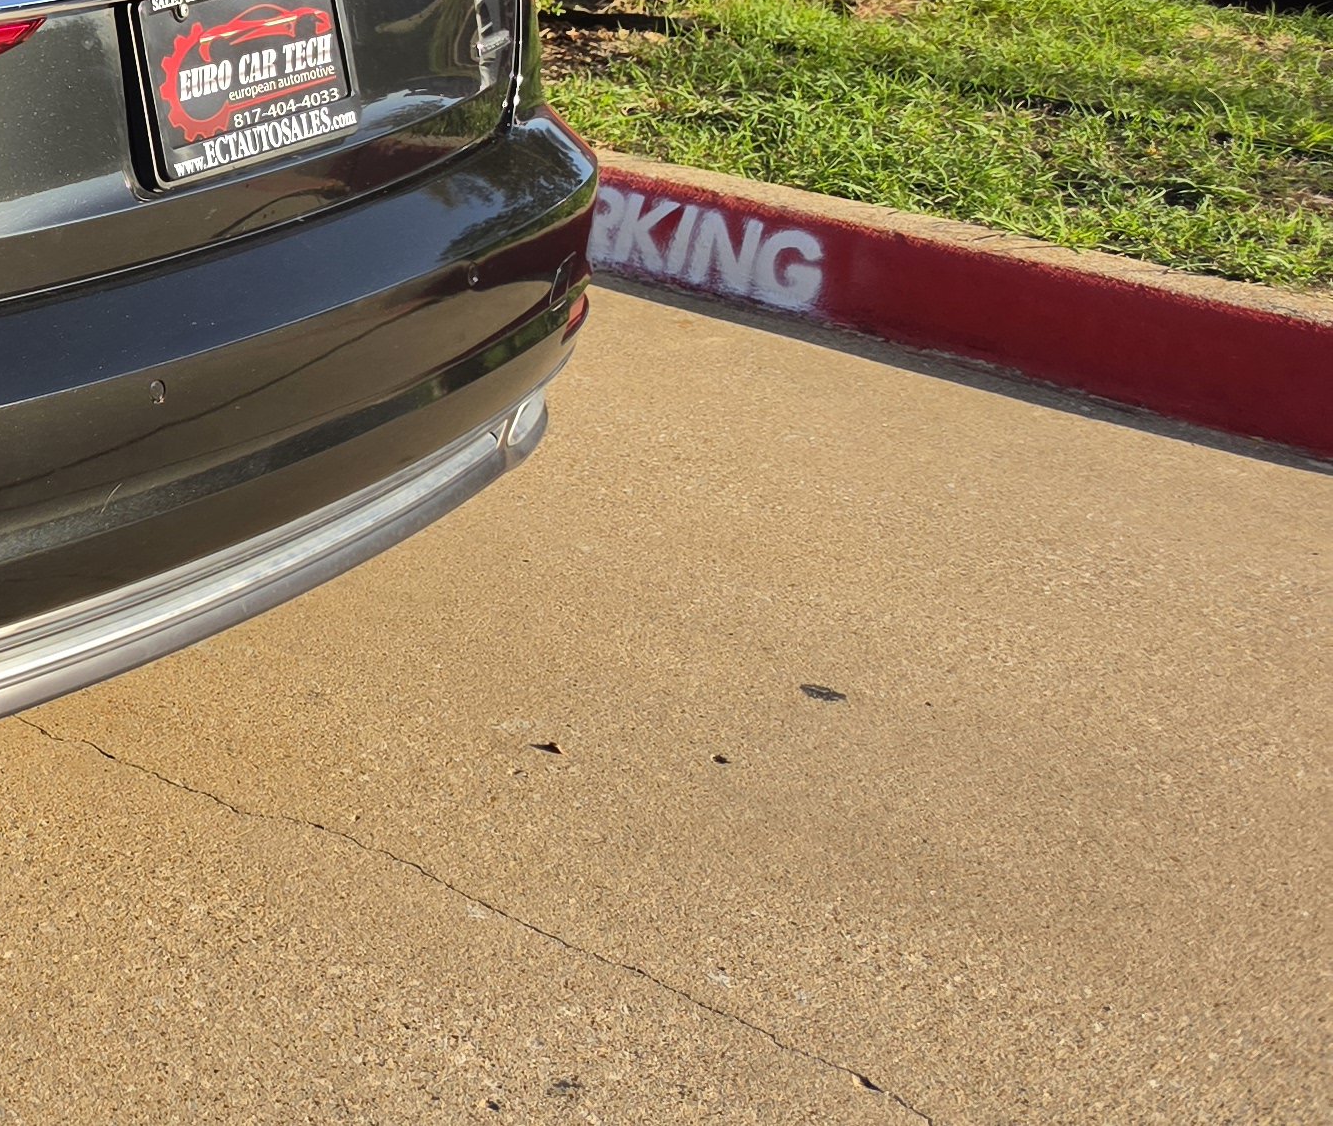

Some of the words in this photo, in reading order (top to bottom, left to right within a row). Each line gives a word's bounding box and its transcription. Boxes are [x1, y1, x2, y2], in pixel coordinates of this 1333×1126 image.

[179, 58, 233, 102] EURO
[238, 47, 277, 87] CAR
[282, 33, 333, 74] TECH
[229, 78, 277, 102] european
[278, 63, 335, 89] automotive
[233, 87, 340, 129] 817-404-4033
[174, 107, 358, 178] www.ECTAUTOSALES.com
